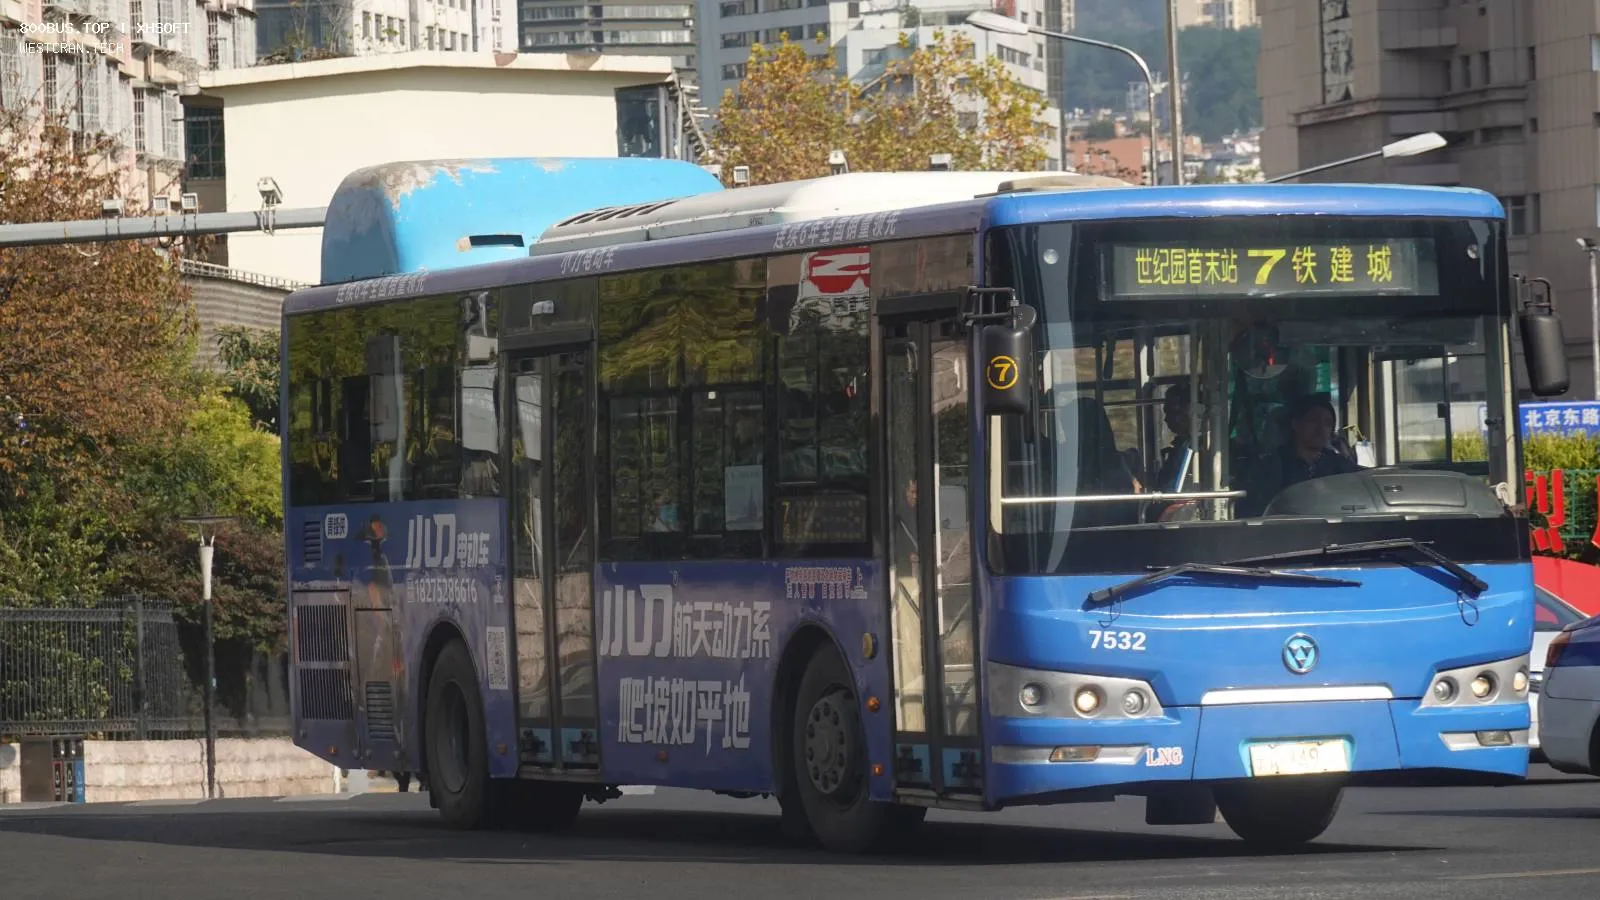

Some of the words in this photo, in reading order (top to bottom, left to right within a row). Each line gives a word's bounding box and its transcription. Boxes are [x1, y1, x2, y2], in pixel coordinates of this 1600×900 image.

[1135, 247, 1238, 285] 世纪园首末站
[1247, 248, 1286, 285] 7
[993, 363, 1012, 382] 7
[1525, 407, 1600, 428] 北京东路
[414, 577, 478, 603] 18275286616
[1088, 630, 1146, 650] 7532
[617, 672, 751, 757] 爬坡如平地
[1145, 746, 1184, 767] LNG
